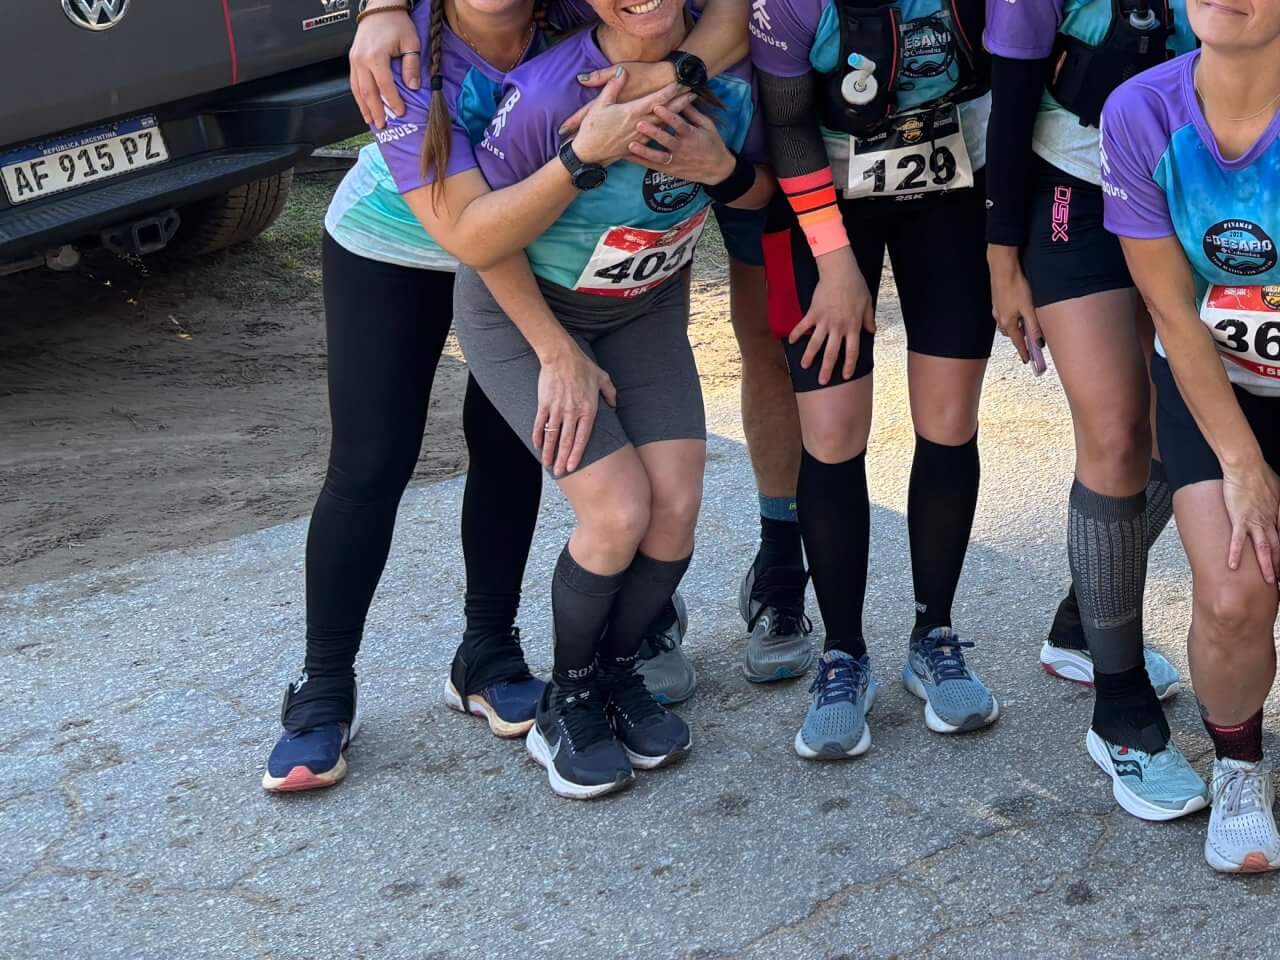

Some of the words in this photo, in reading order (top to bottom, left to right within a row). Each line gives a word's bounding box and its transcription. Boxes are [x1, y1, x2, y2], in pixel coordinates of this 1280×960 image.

[14, 161, 49, 195] AF
[59, 143, 115, 182] 915
[119, 132, 160, 164] PZ
[863, 146, 956, 193] 129
